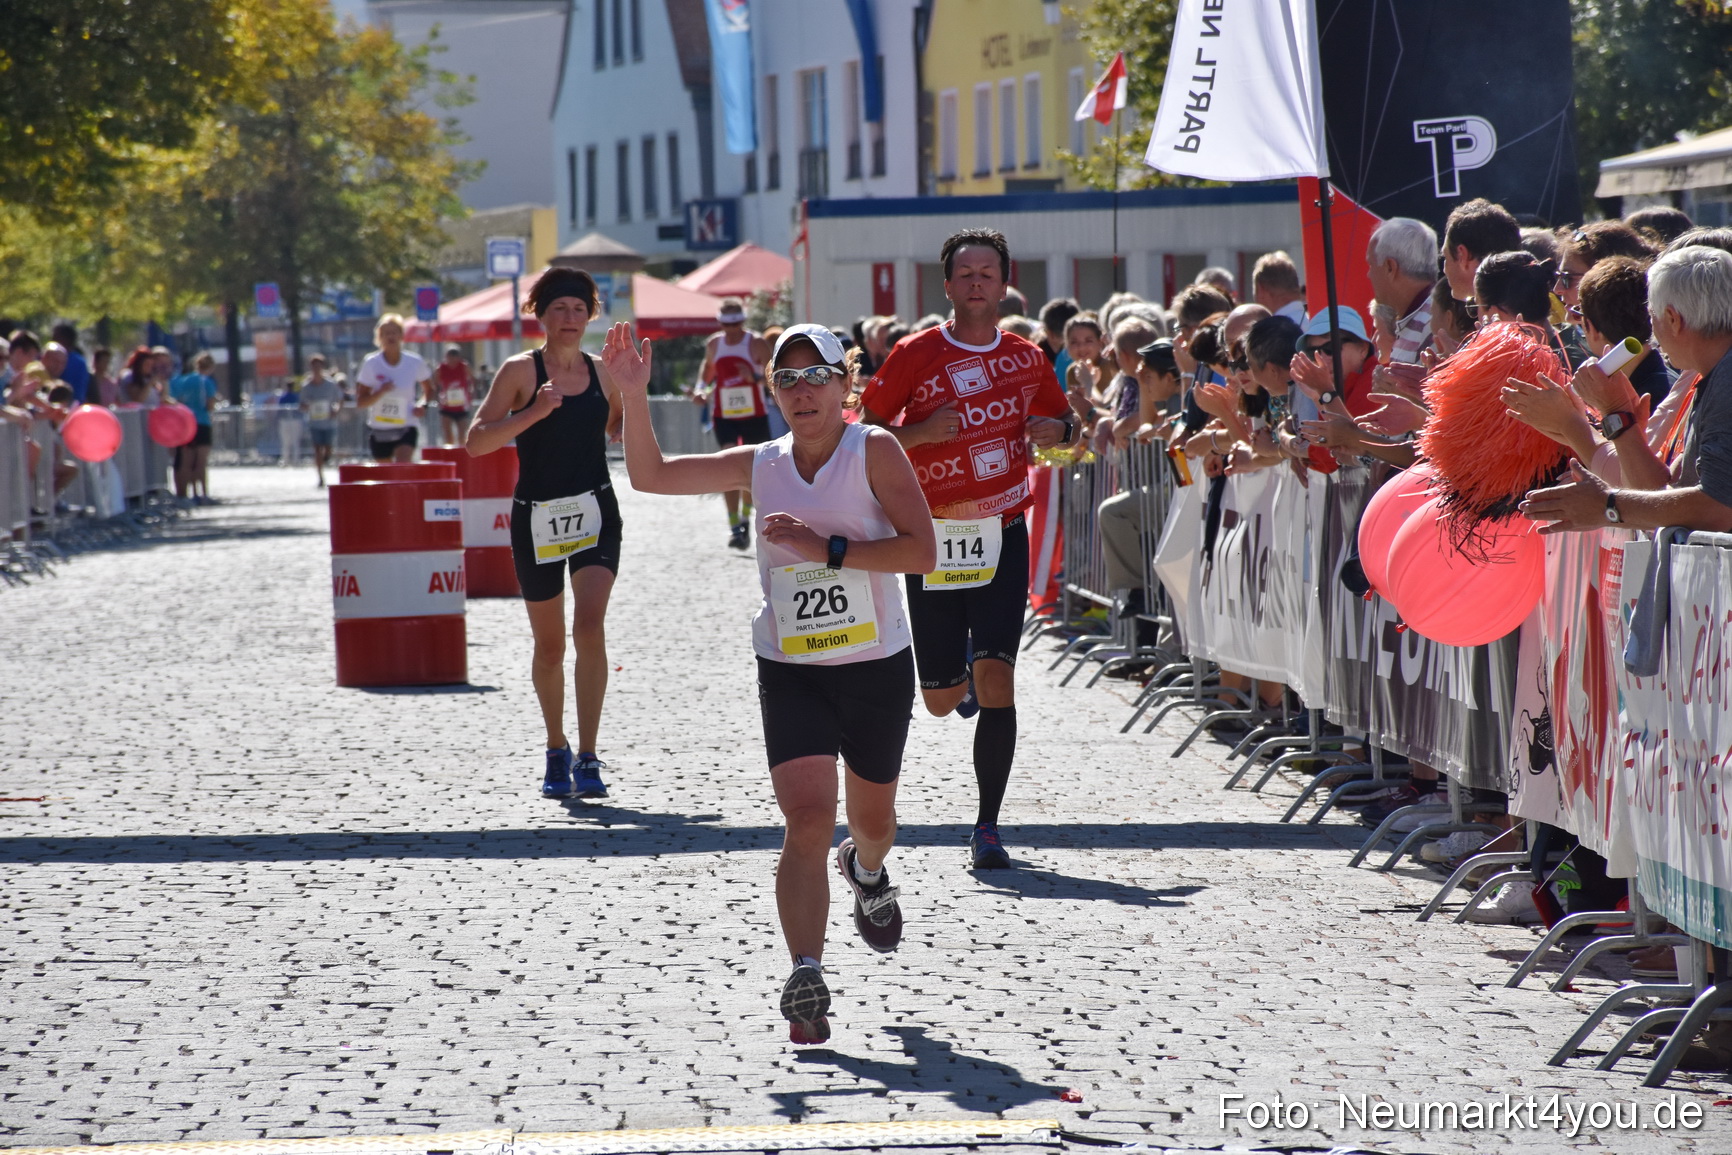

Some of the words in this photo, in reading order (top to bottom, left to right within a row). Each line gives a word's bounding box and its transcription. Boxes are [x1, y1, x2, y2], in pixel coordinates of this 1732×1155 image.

[1420, 126, 1444, 135] Team
[1445, 123, 1467, 133] Partl
[949, 359, 981, 374] raumbox
[997, 373, 1032, 387] schenken
[948, 429, 984, 443] wohnen
[990, 421, 1019, 434] outdoor
[972, 441, 1005, 456] raumbox
[933, 478, 966, 493] outdoor
[549, 502, 580, 514] BOCK
[978, 489, 1019, 512] raumbox
[548, 512, 584, 536] 177
[945, 524, 980, 534] BOCK
[559, 542, 580, 554] Birgit
[943, 537, 984, 559] 114
[796, 568, 838, 583] BOCK
[945, 571, 980, 583] Gerhard
[793, 585, 848, 620] 226
[796, 623, 815, 631] PARTL
[816, 618, 847, 629] Neumarkt
[805, 633, 849, 650] Marion
[922, 680, 940, 688] cep
